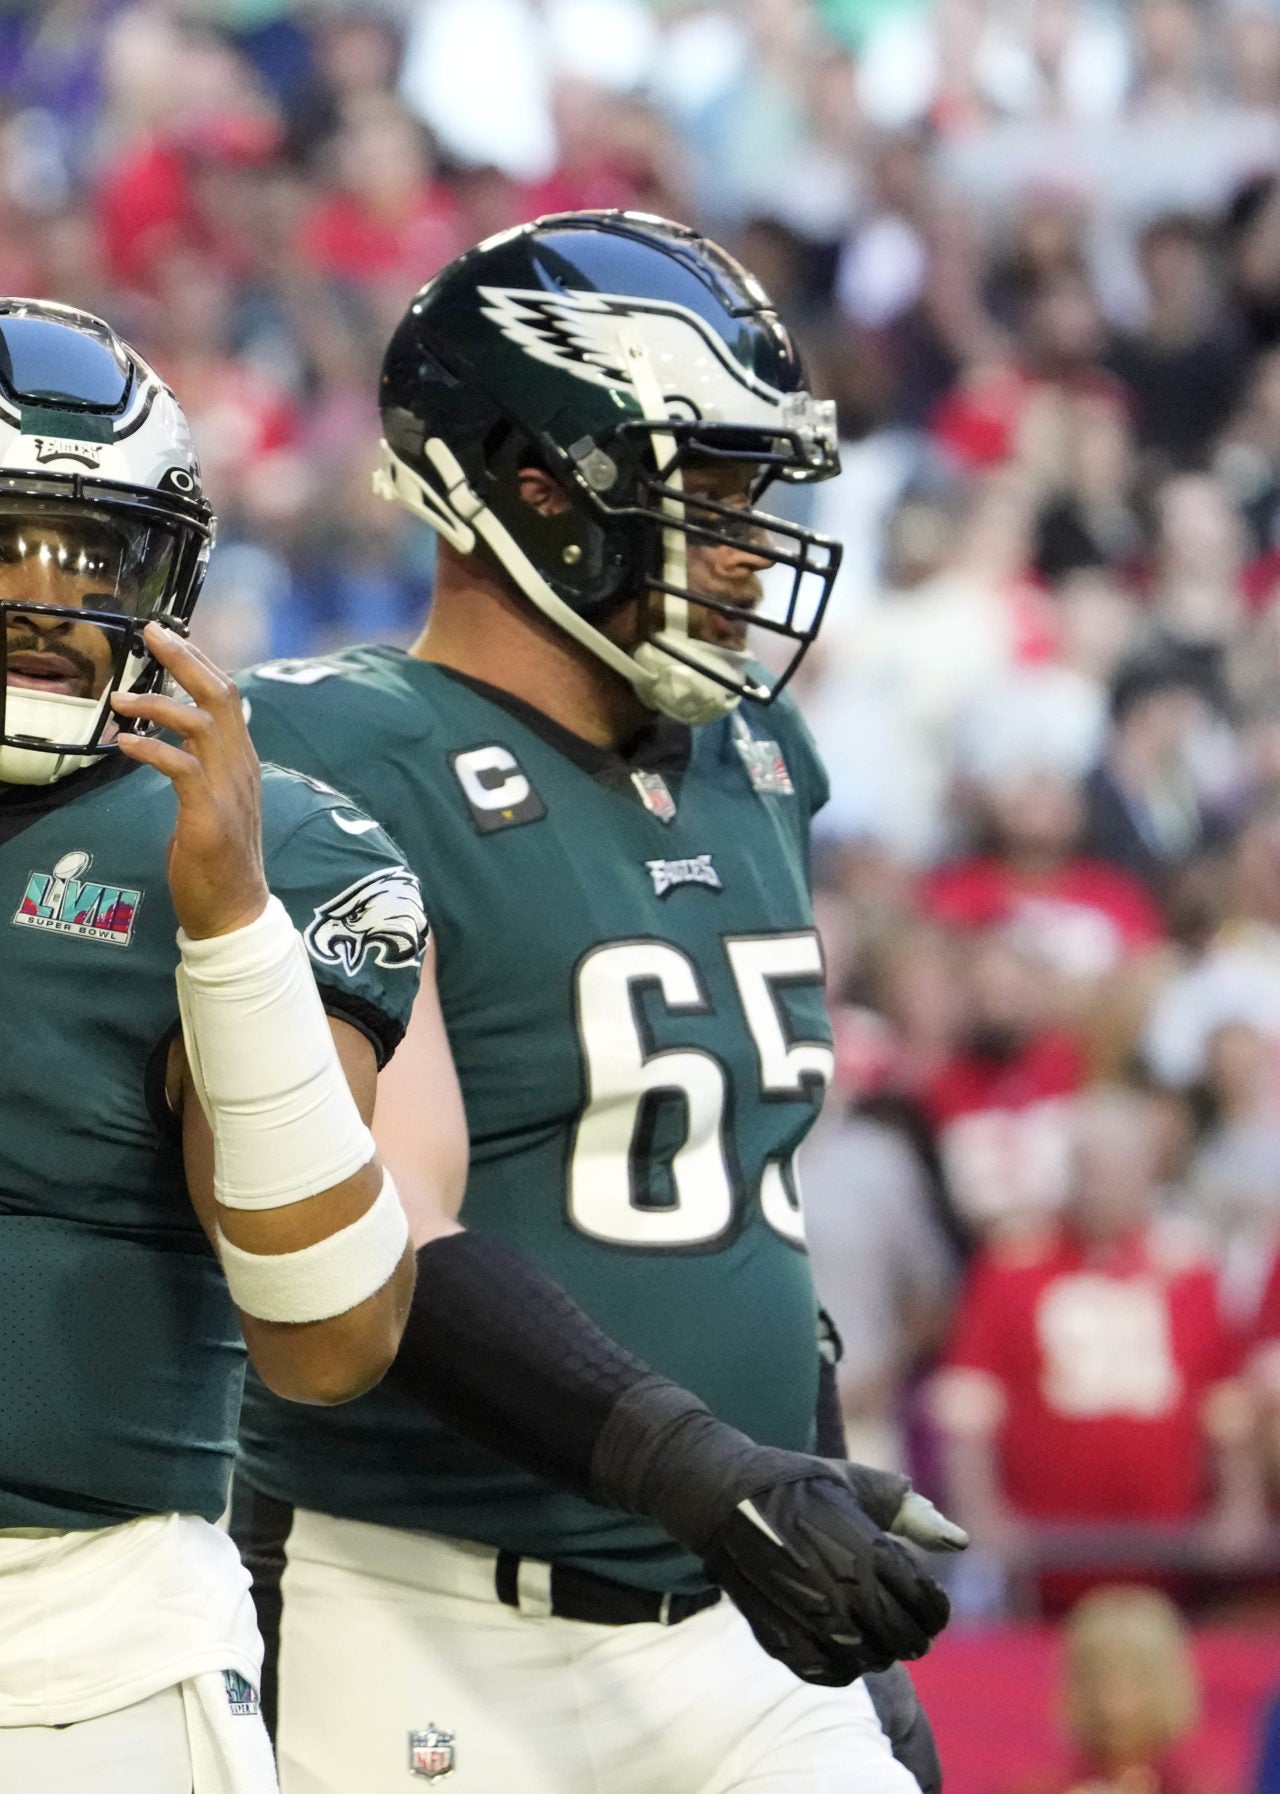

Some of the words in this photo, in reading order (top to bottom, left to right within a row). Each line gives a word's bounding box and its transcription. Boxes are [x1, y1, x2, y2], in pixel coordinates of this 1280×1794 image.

[454, 746, 530, 811] C
[27, 915, 72, 931] SUPER
[78, 926, 117, 940] BOWL
[570, 931, 834, 1249] 65
